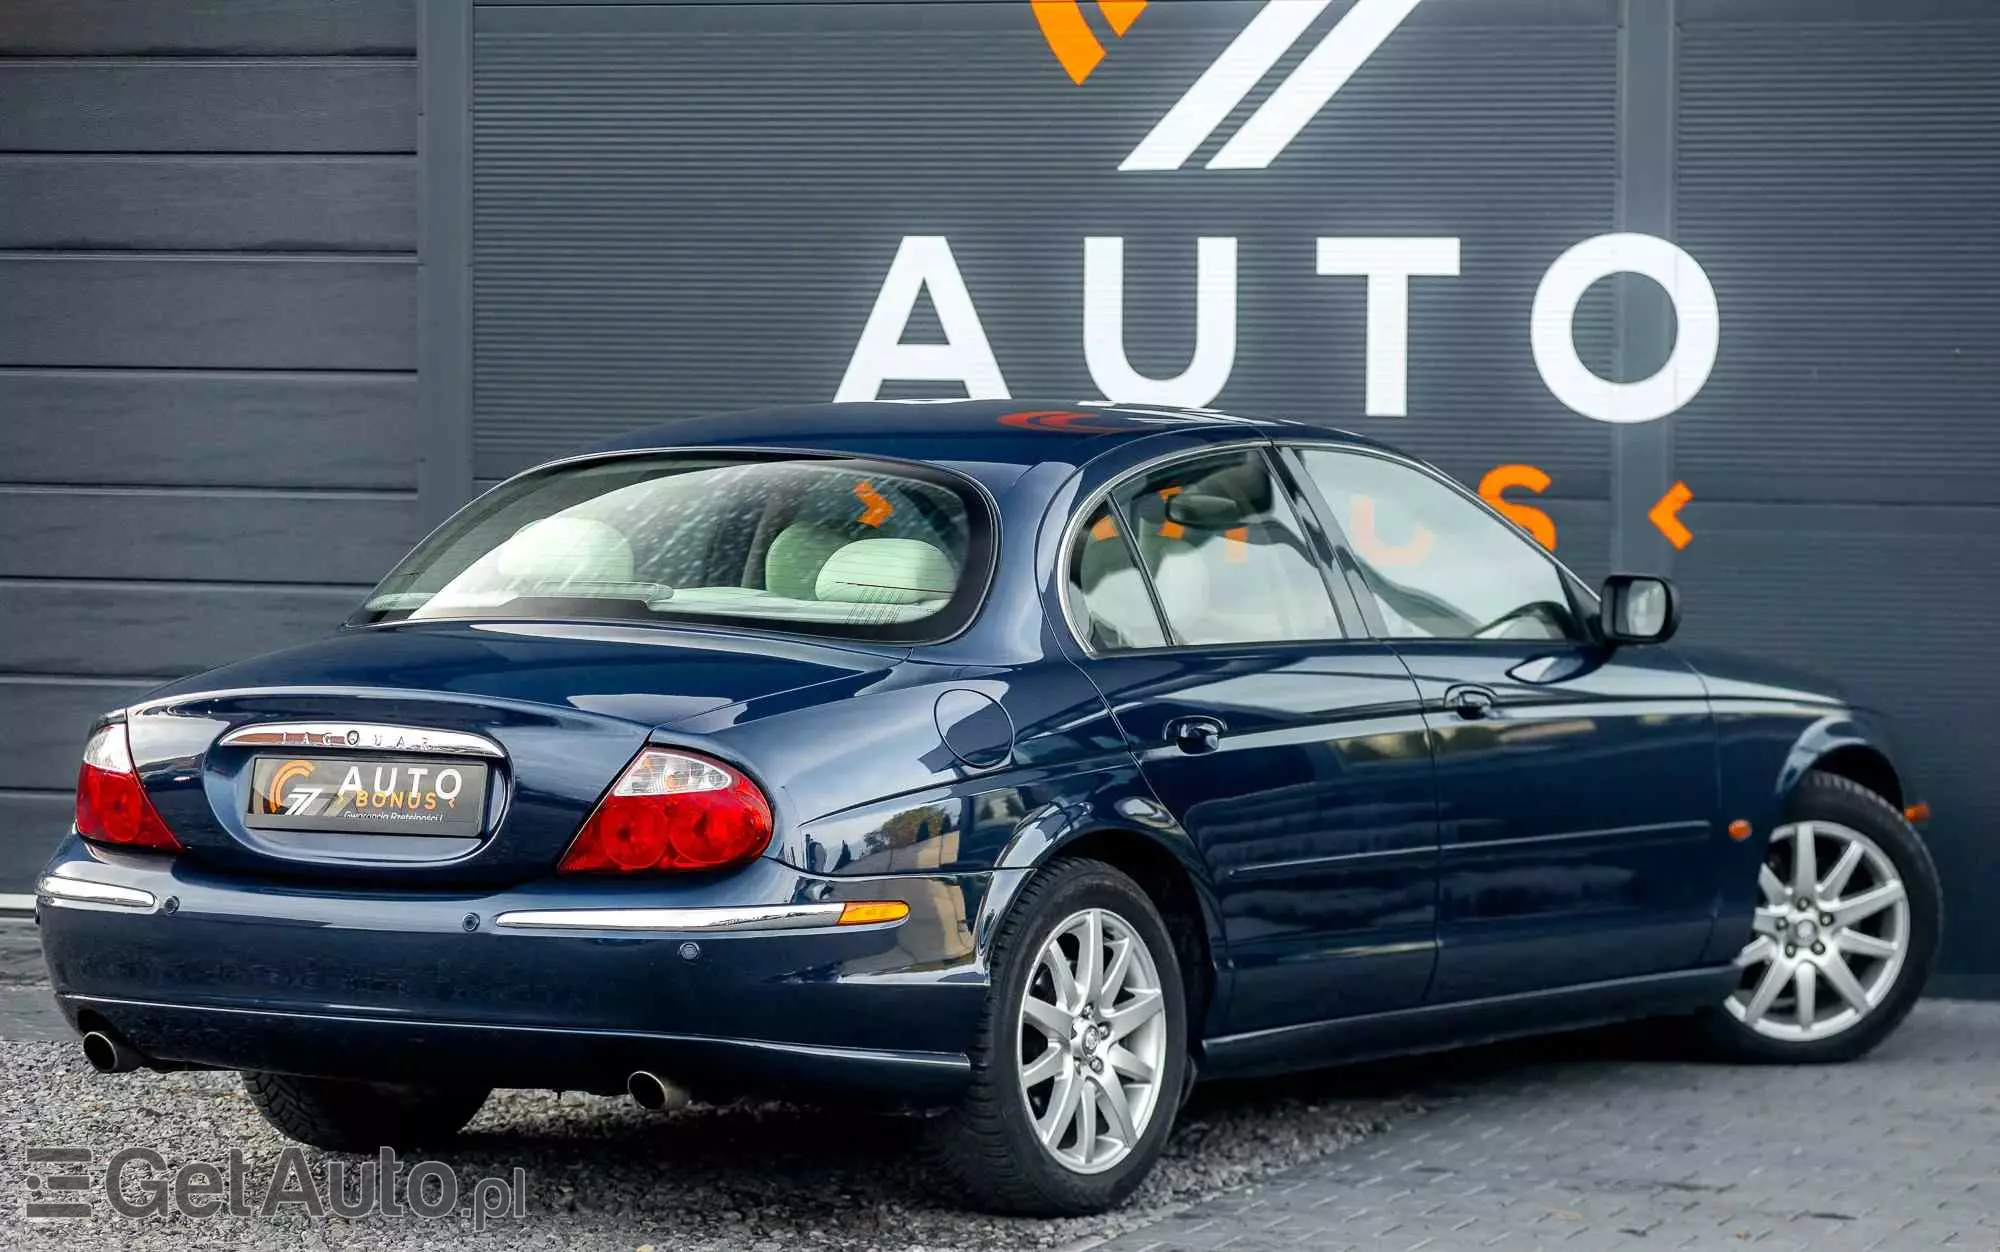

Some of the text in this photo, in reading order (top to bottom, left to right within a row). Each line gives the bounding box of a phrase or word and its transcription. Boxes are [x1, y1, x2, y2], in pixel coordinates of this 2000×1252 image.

[834, 232, 1720, 423] AUTO
[337, 765, 463, 801] AUTO
[355, 789, 437, 810] BONUS
